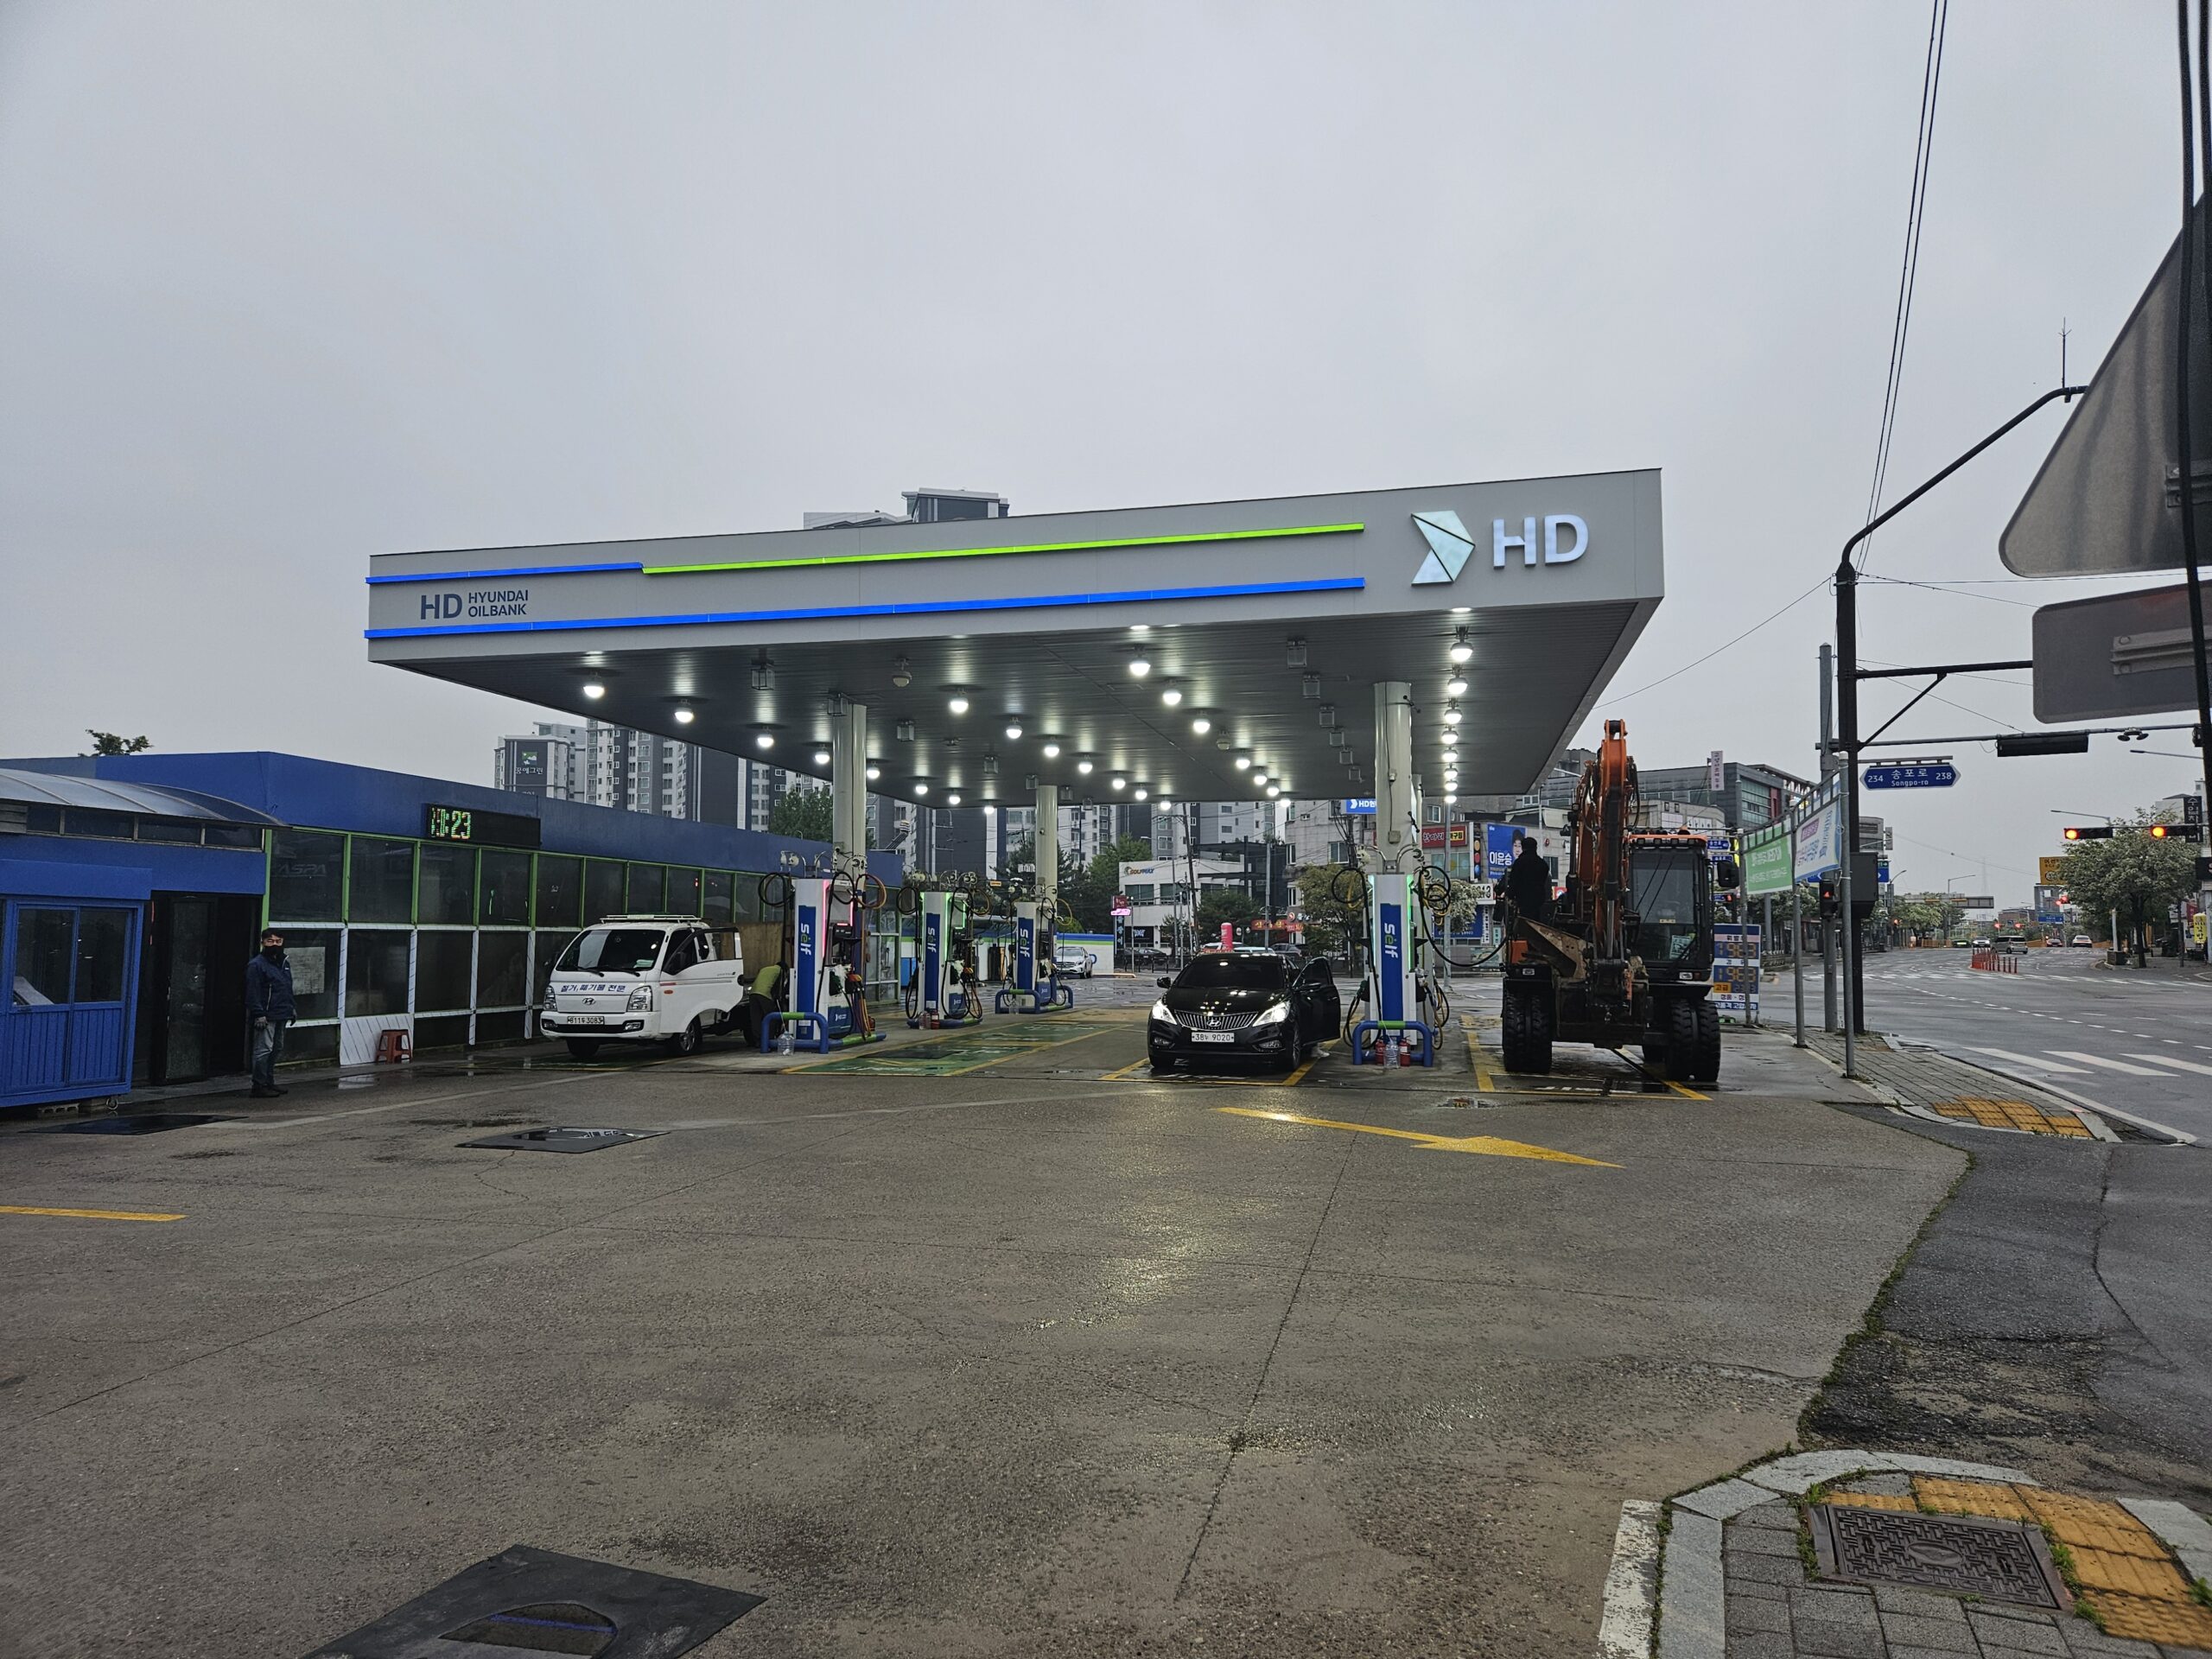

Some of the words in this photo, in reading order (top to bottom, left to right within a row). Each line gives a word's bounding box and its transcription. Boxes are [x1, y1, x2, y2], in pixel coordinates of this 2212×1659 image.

[1493, 514, 1589, 569] HD
[468, 589, 529, 604] HYUNDAI
[420, 593, 462, 620] HD
[467, 604, 527, 618] OILBANK
[1867, 774, 1884, 783] 234
[1891, 768, 1929, 780] 송포로
[1936, 772, 1952, 780] 238
[1489, 851, 1512, 866] 이윤승
